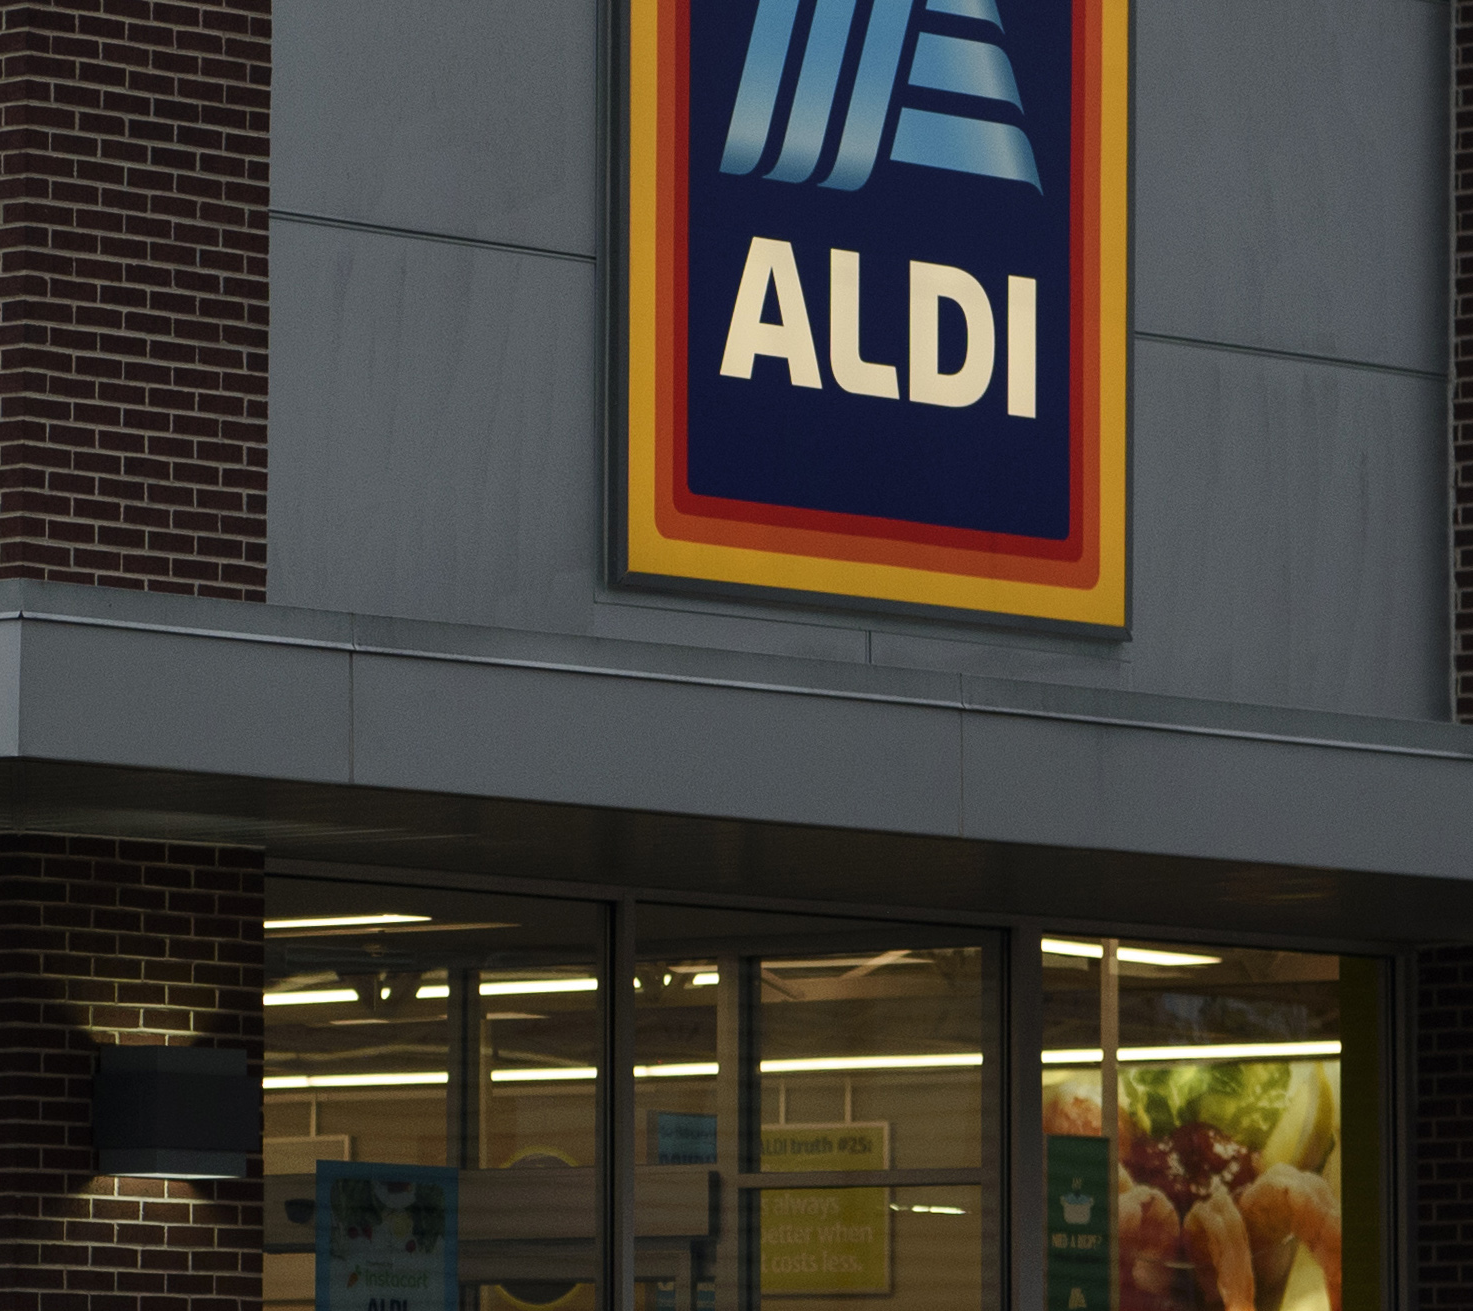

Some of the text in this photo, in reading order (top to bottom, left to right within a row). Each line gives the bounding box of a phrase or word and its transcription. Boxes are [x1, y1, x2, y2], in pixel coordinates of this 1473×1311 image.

[719, 236, 1037, 419] ALDI
[790, 1137, 833, 1154] truth
[773, 1193, 840, 1220] always
[817, 1222, 873, 1243] when
[771, 1253, 818, 1273] costs
[823, 1250, 863, 1272] less.
[365, 1269, 429, 1288] instacart
